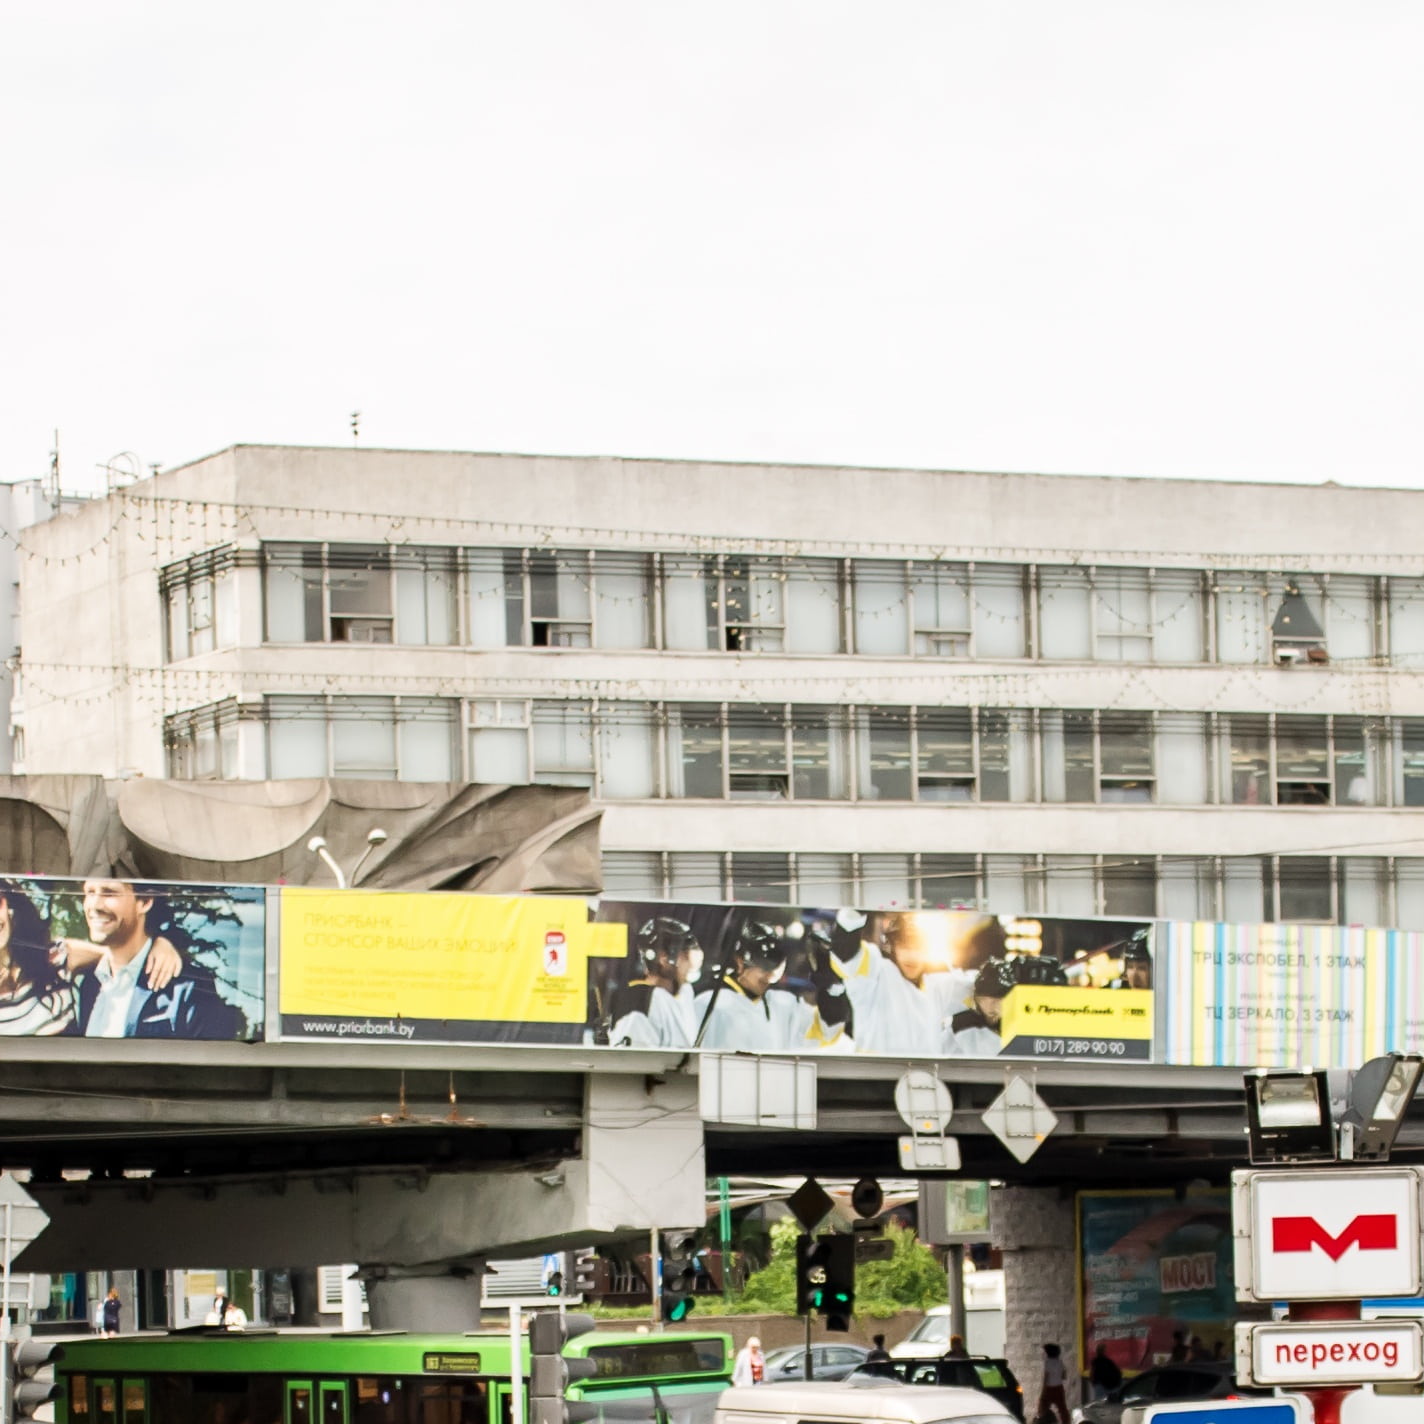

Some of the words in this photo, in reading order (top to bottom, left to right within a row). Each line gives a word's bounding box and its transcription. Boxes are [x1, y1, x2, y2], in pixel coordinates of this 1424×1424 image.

[303, 933, 382, 949] СПОНСОР
[387, 937, 440, 951] ВАШИХ
[1192, 950, 1222, 967] ТРЦ
[1312, 955, 1319, 968] 1
[1325, 955, 1366, 968] ЭТАЖ
[1205, 1006, 1222, 1021] ТЦ
[1301, 1009, 1310, 1022] 3
[1312, 1009, 1353, 1023] ЭТАЖ
[303, 1019, 416, 1040] www.priorbank.by
[1033, 1039, 1065, 1055] (017)
[1067, 1040, 1090, 1054] 289
[1092, 1041, 1108, 1055] 90
[1109, 1042, 1125, 1055] 90
[1162, 1254, 1216, 1291] МОСТ
[1275, 1339, 1400, 1369] переход
